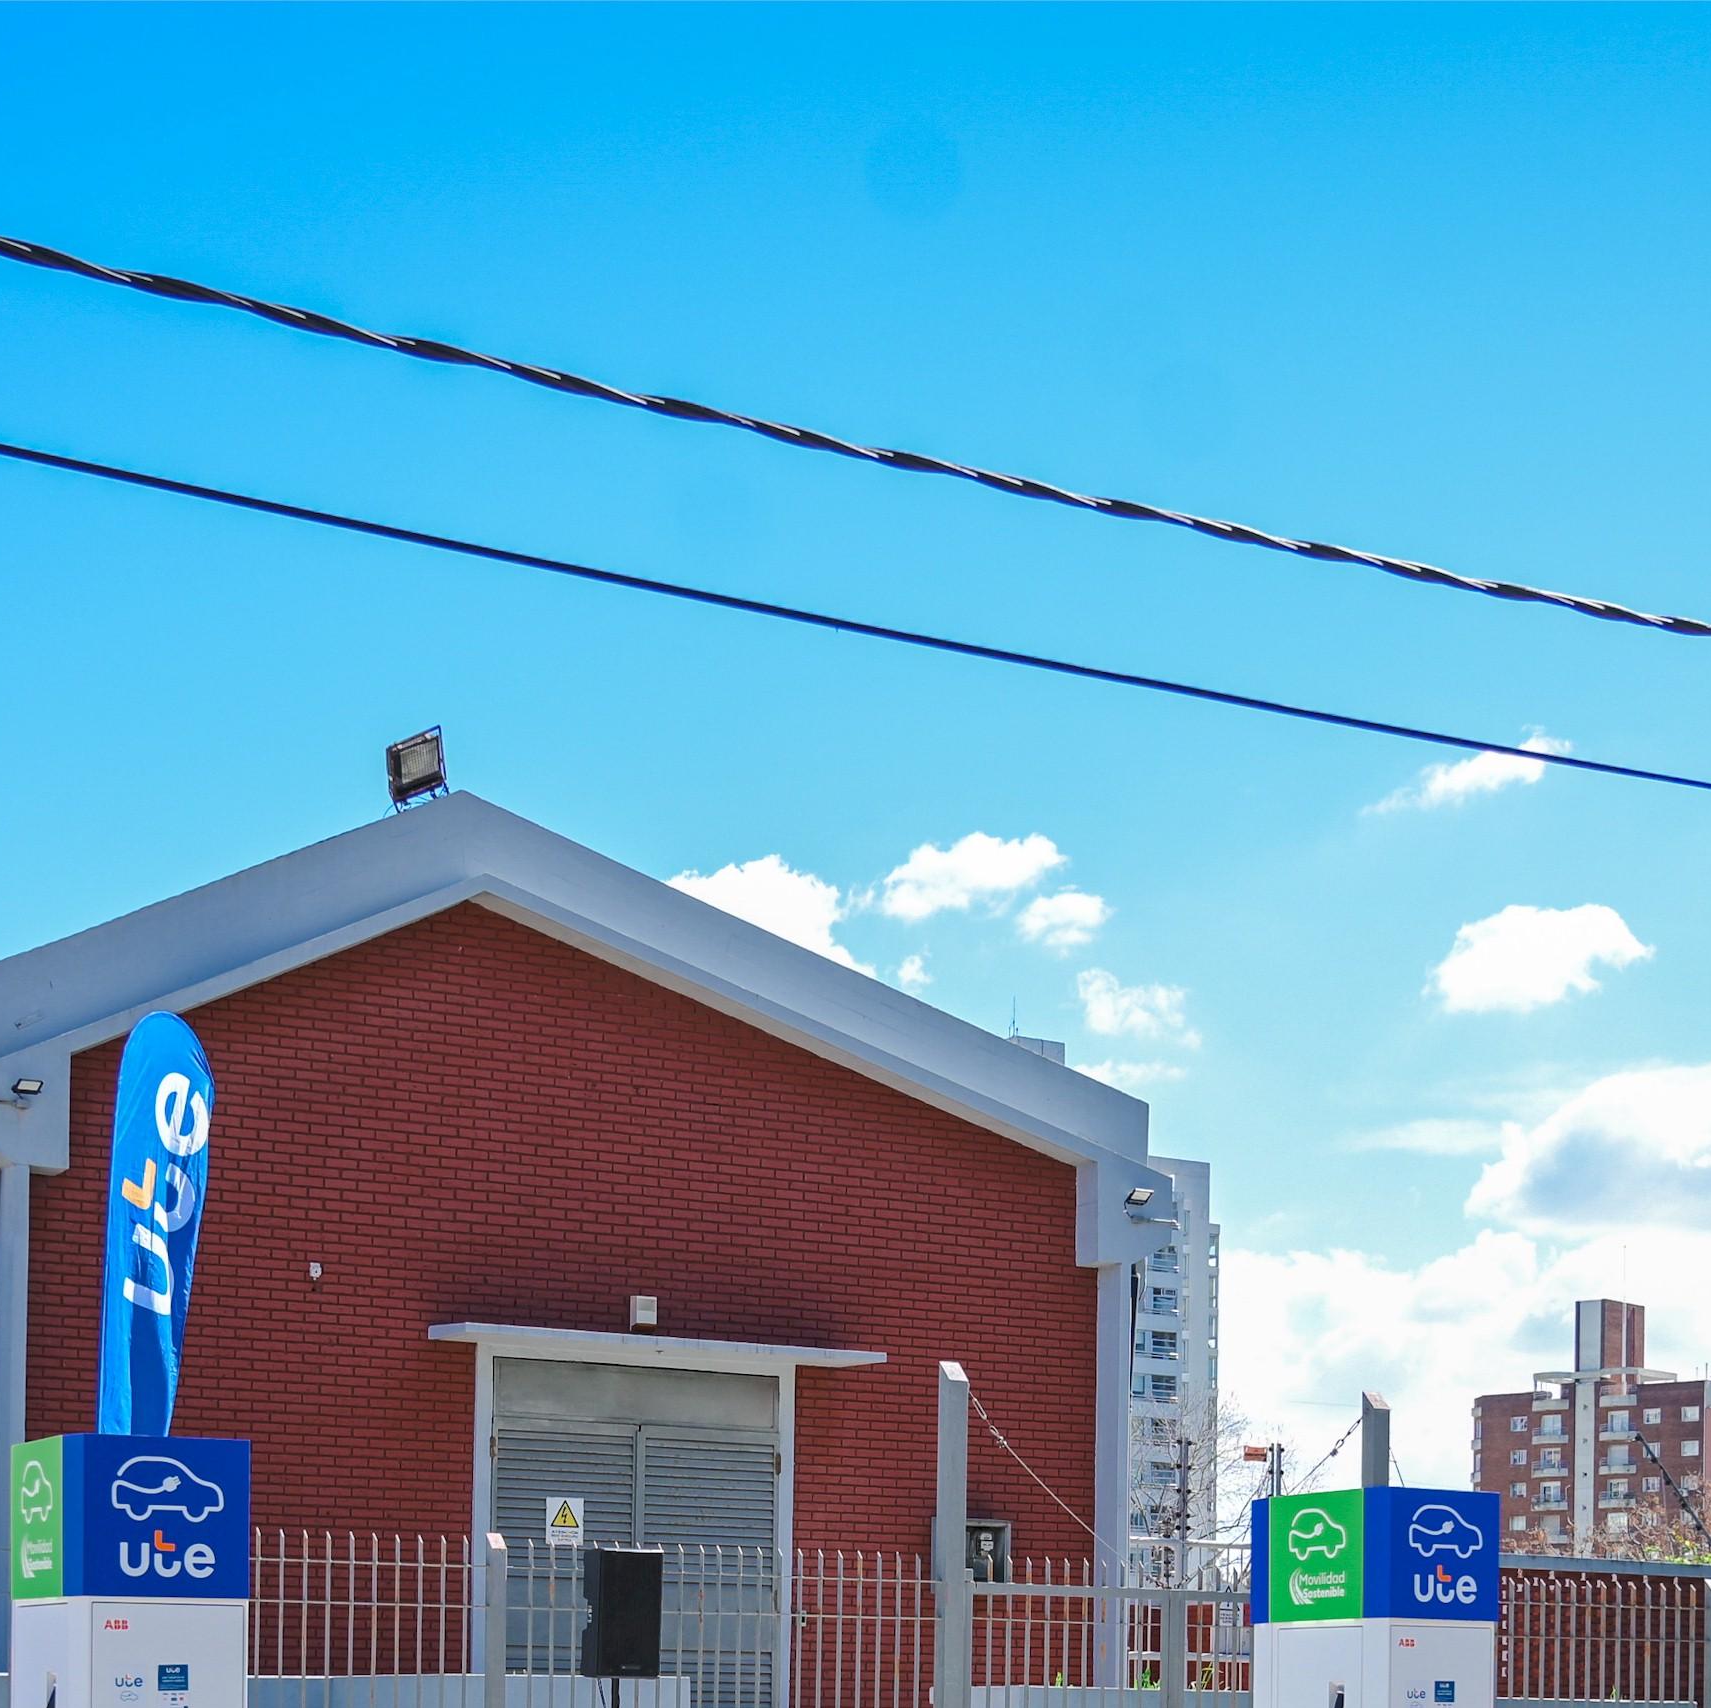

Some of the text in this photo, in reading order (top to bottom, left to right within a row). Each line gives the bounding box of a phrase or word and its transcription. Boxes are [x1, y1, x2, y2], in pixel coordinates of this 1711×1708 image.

[122, 1072, 210, 1316] ute
[119, 1530, 216, 1578] ute
[1299, 1570, 1346, 1585] Movilidad
[1414, 1564, 1478, 1603] ute
[1303, 1585, 1346, 1599] Sostenible
[104, 1619, 129, 1630] ABB
[115, 1674, 143, 1687] ute
